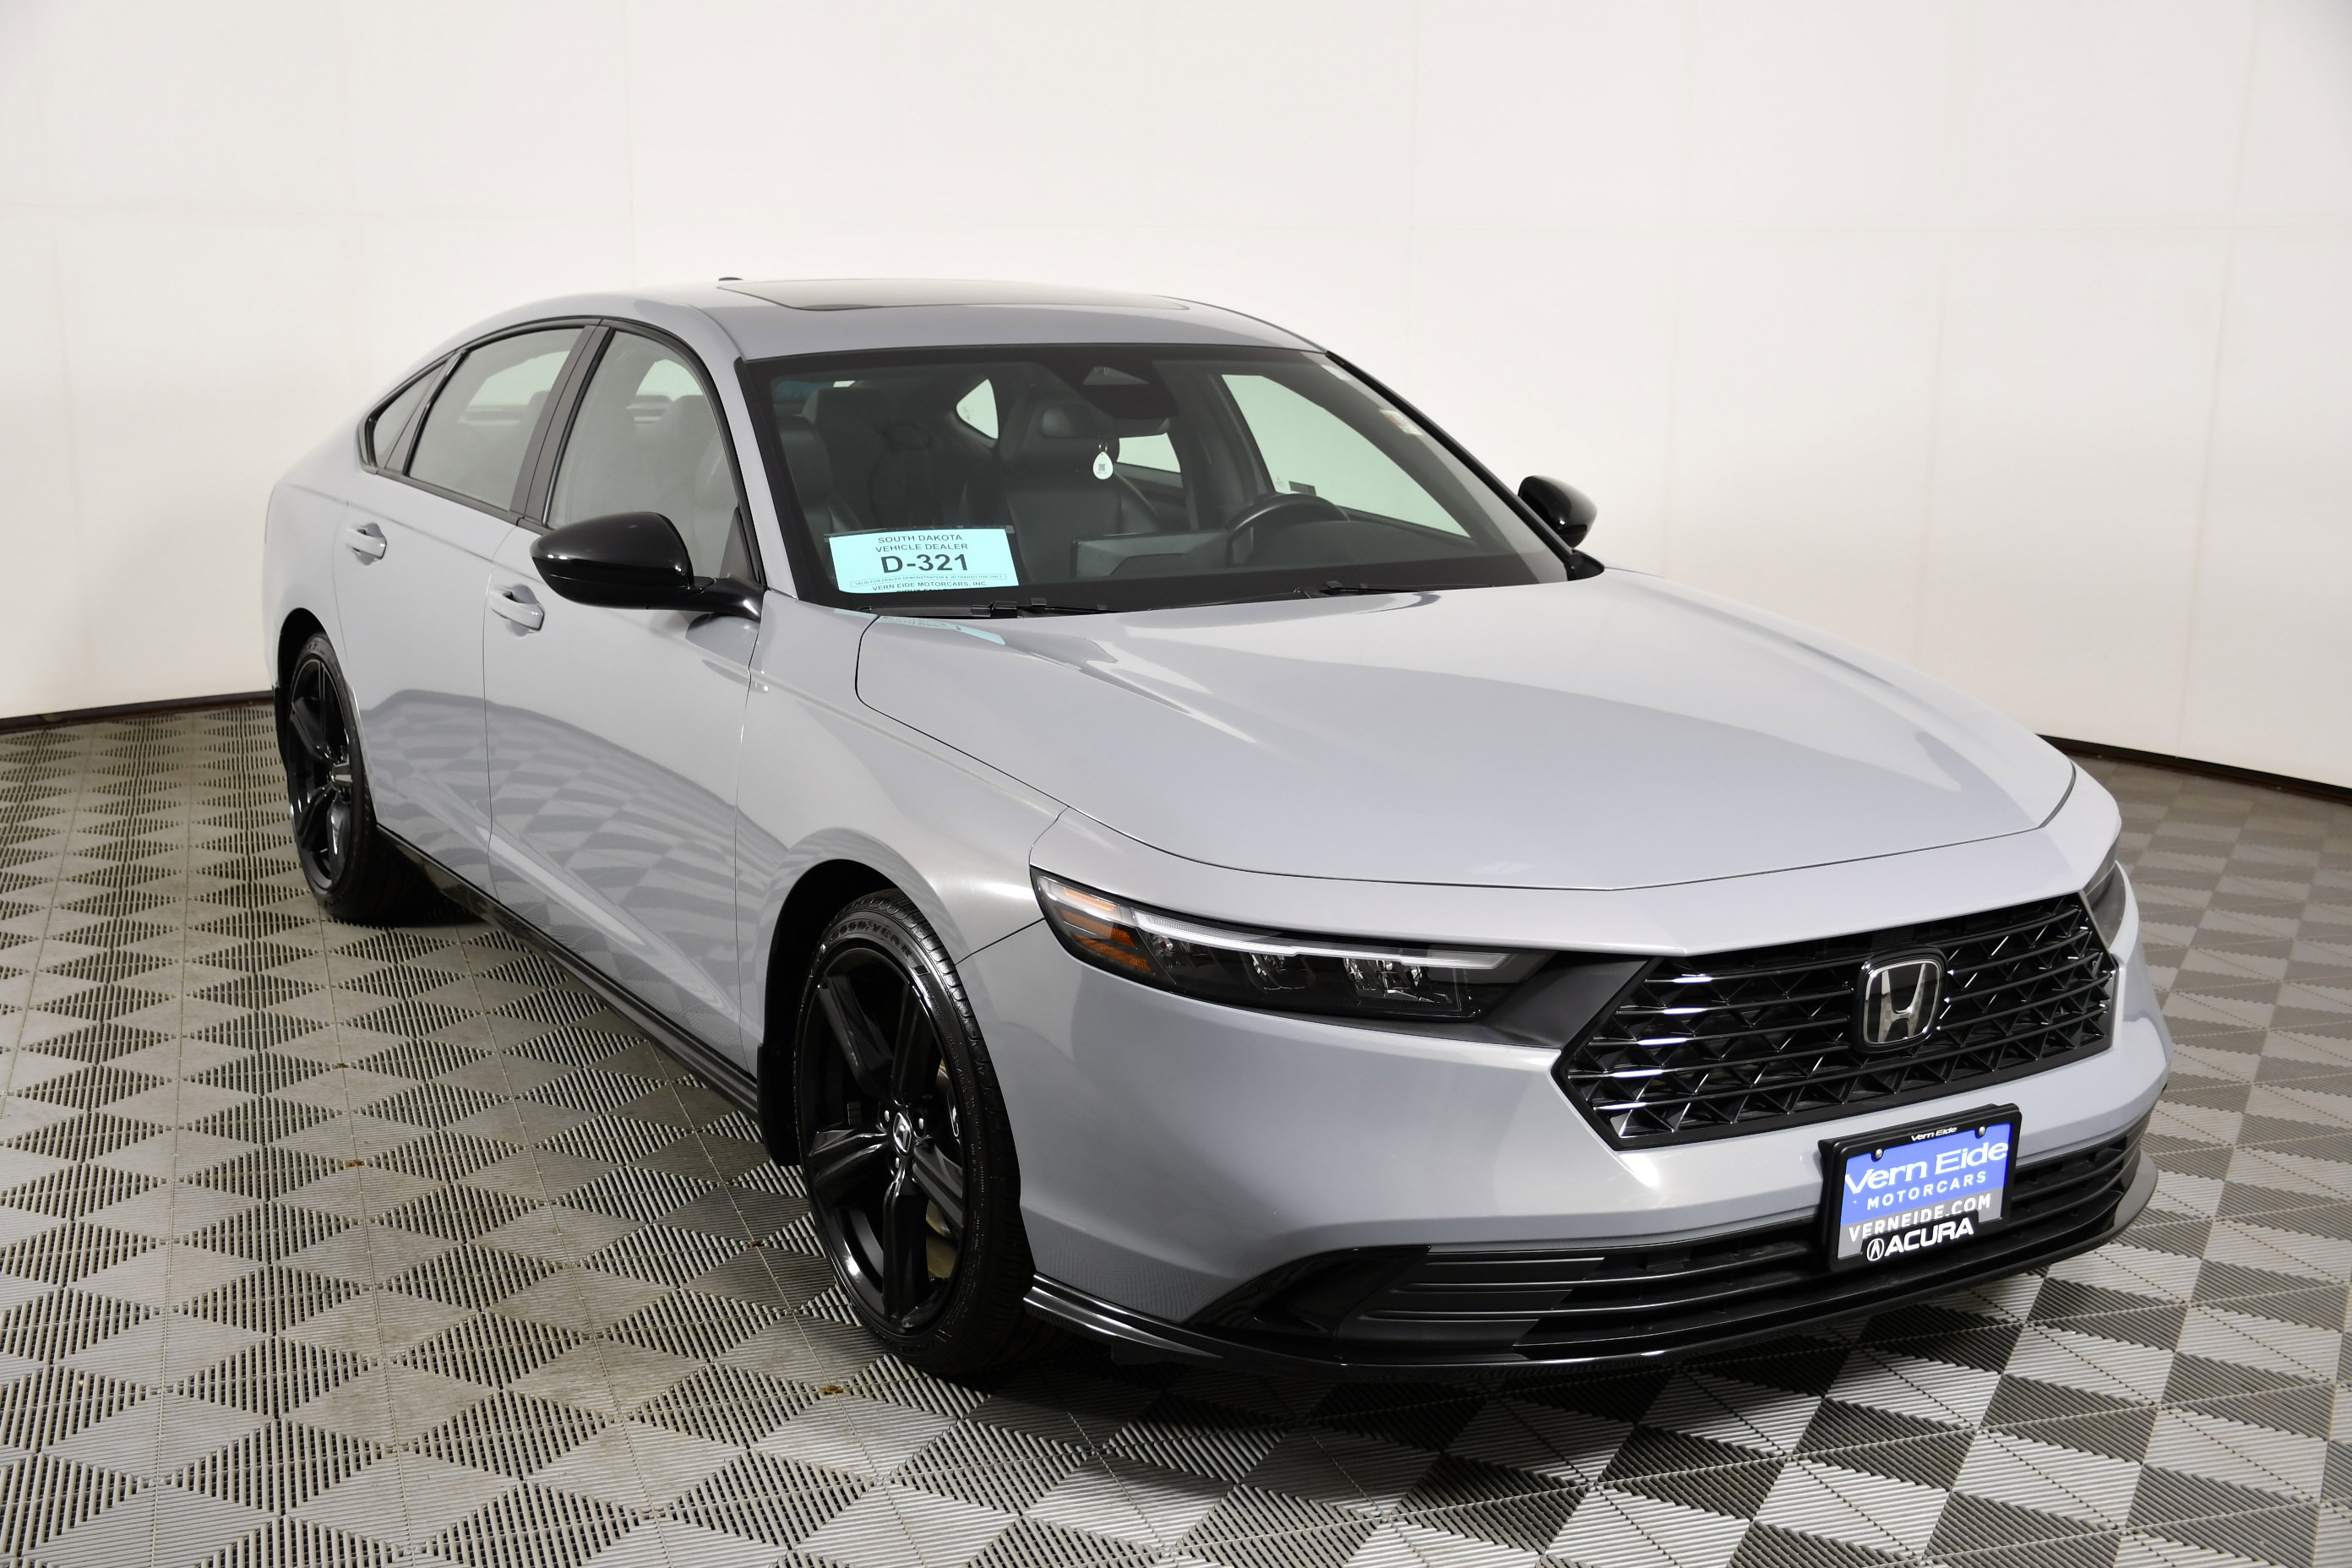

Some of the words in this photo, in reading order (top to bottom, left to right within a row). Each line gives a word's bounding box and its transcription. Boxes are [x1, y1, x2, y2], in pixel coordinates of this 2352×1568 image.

[875, 543, 922, 553] VEHICLE
[878, 535, 916, 544] SOUTH
[880, 553, 968, 574] D-321
[1910, 1130, 1936, 1141] Vern
[1936, 1126, 1957, 1136] Eide
[1844, 1161, 1927, 1195] Vern
[1935, 1141, 2009, 1175] Eide
[1866, 1170, 1987, 1211] MOTORCARS
[1848, 1193, 1991, 1242] VERNEIDE.COM
[1883, 1217, 1974, 1257] ACURA
